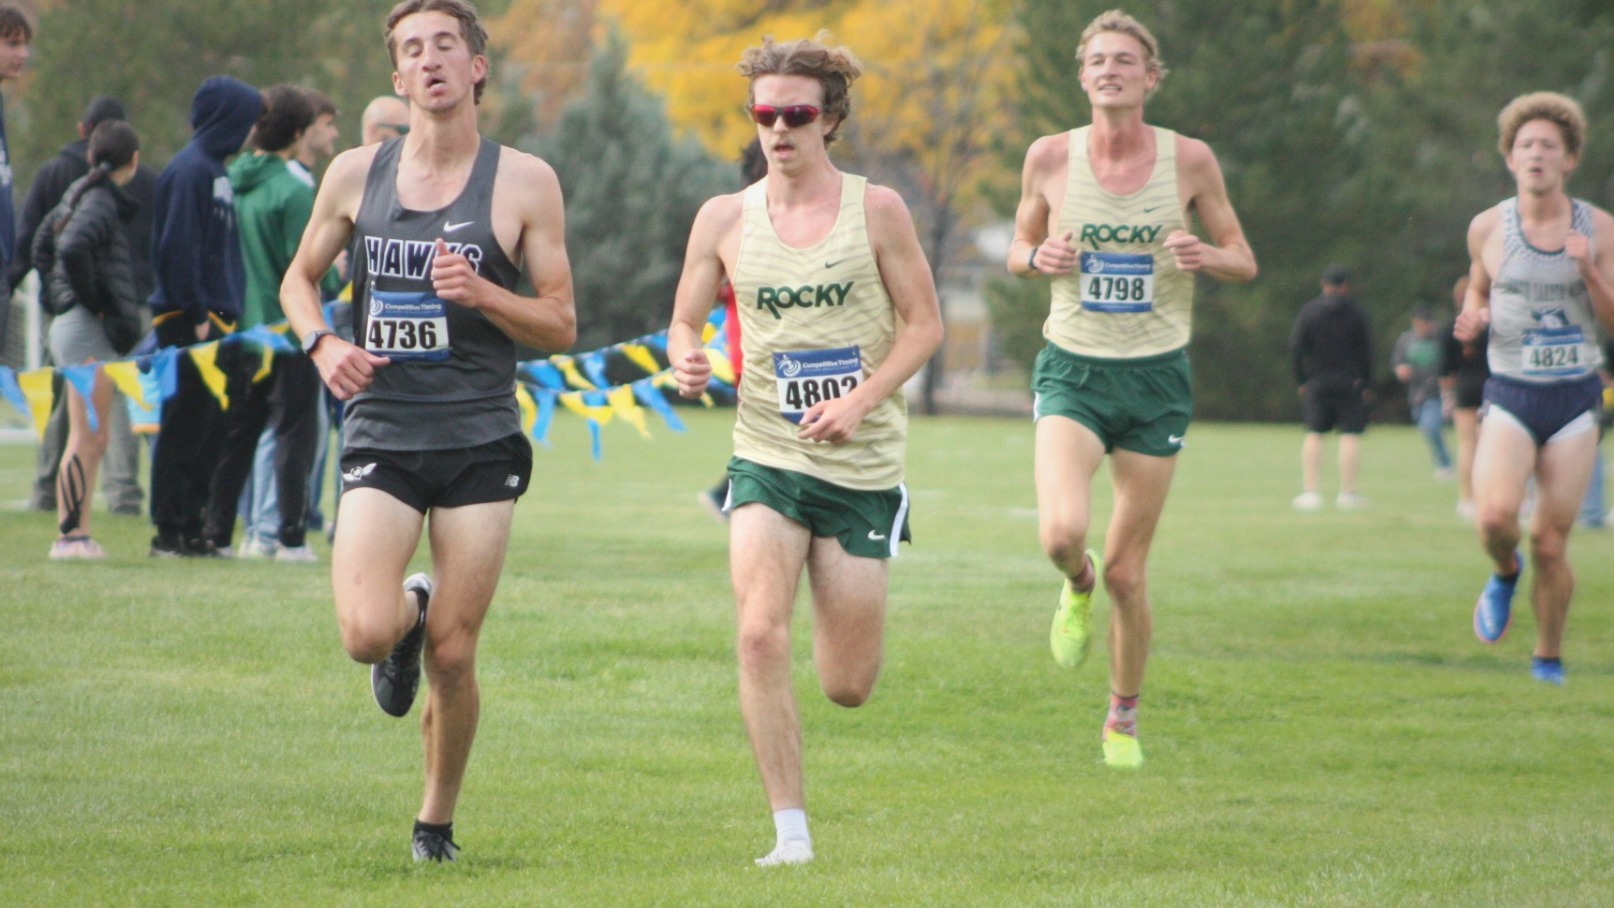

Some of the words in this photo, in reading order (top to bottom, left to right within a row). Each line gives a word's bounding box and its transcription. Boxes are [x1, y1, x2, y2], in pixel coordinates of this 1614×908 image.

[1080, 223, 1162, 250] ROCKY
[757, 281, 854, 319] ROCKY
[1088, 276, 1144, 301] 4798
[368, 320, 437, 349] 4736
[802, 360, 838, 368] Competitive
[1529, 346, 1579, 367] 4824
